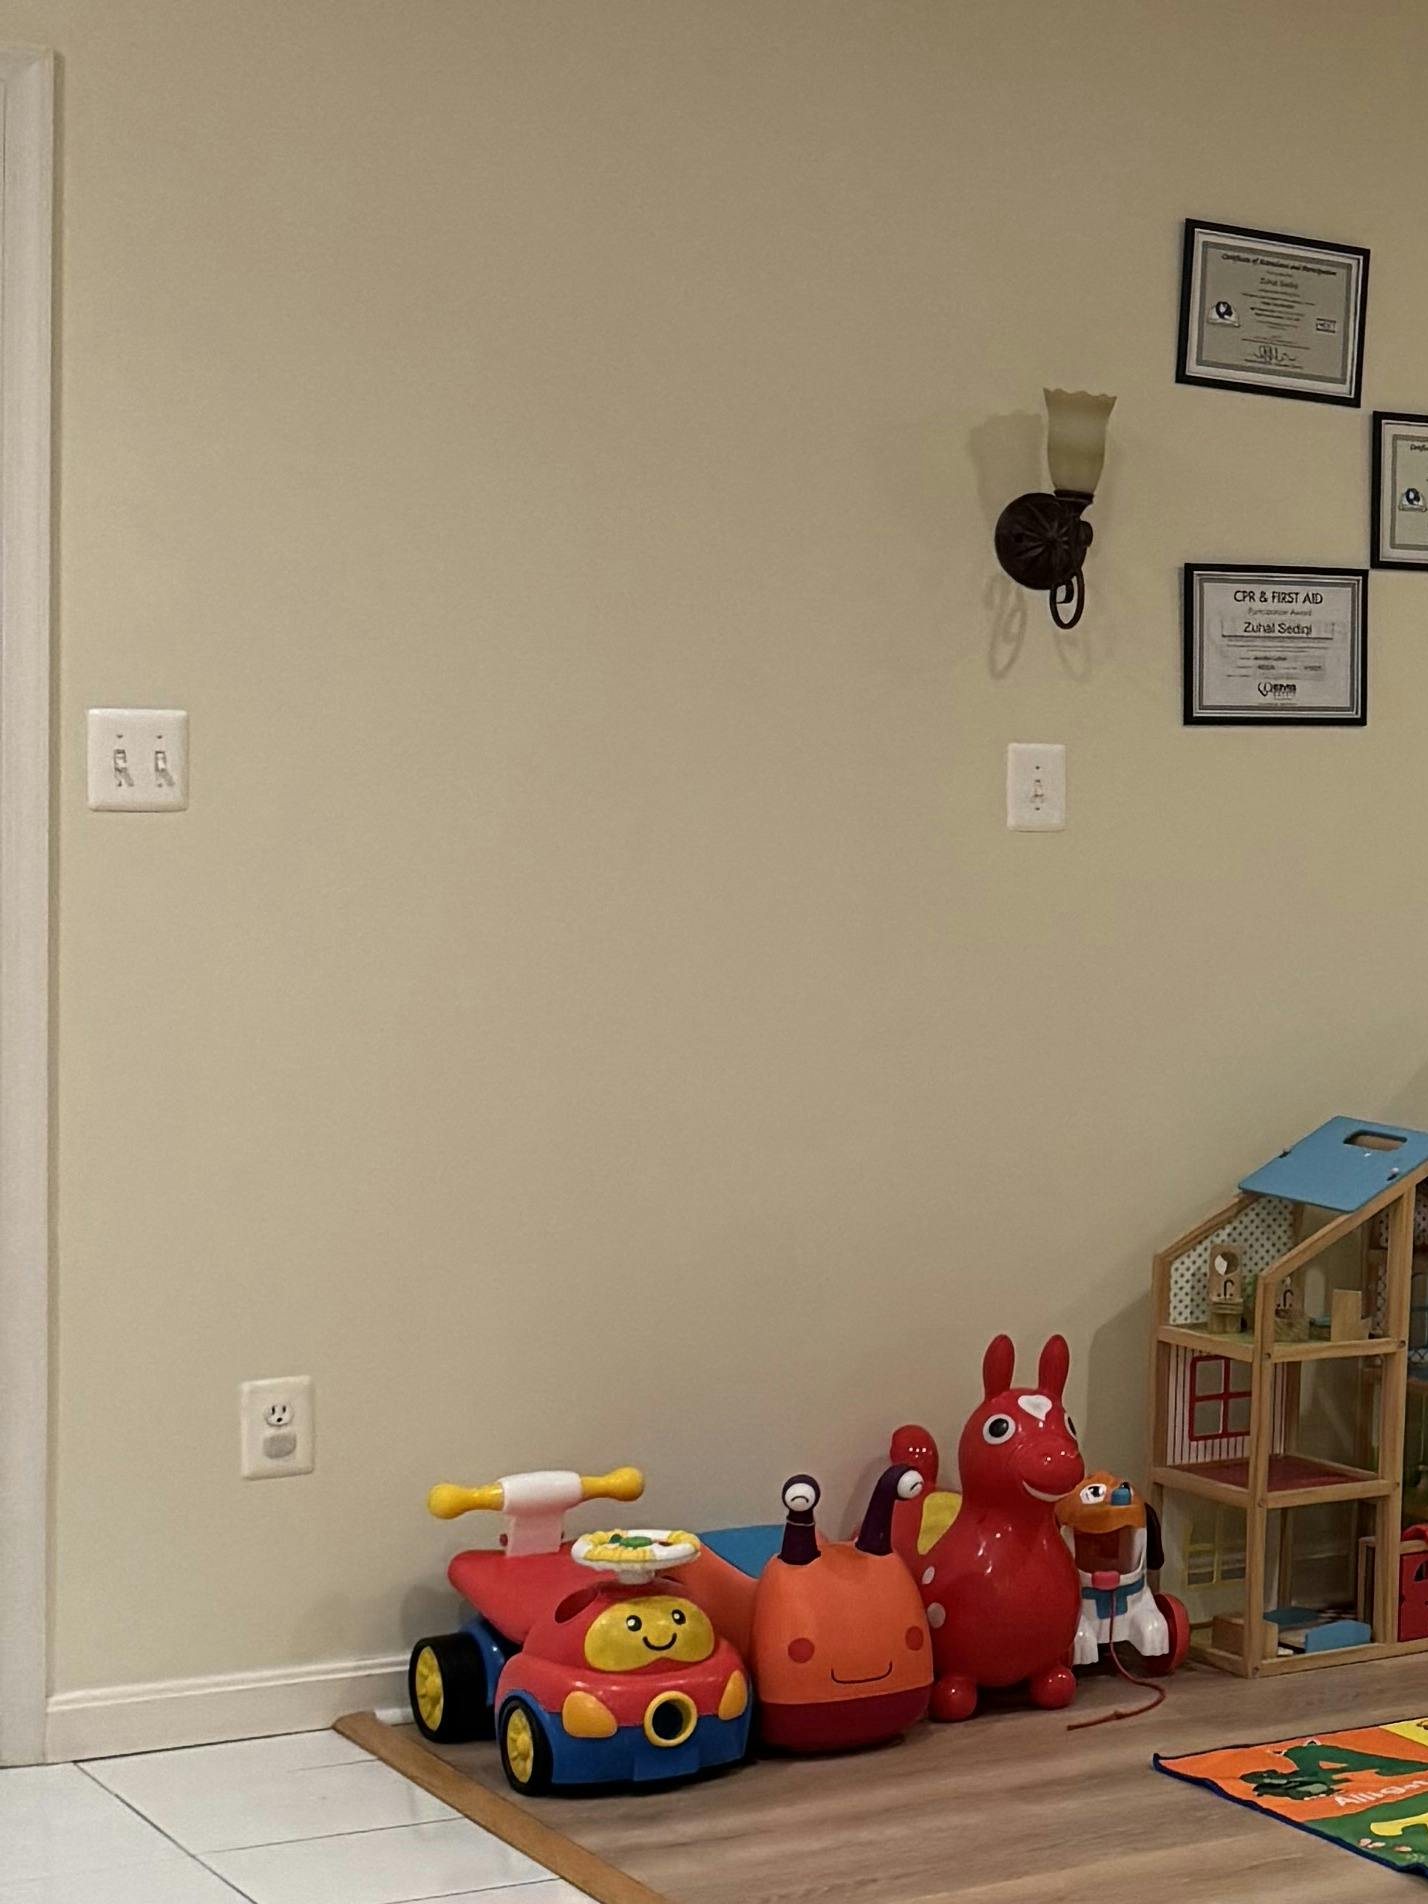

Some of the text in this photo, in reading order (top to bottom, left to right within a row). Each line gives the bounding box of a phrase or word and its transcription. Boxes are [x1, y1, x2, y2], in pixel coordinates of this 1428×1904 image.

[1233, 590, 1323, 604] CPR & FIRST AID
[1243, 622, 1275, 634] Zuhal
